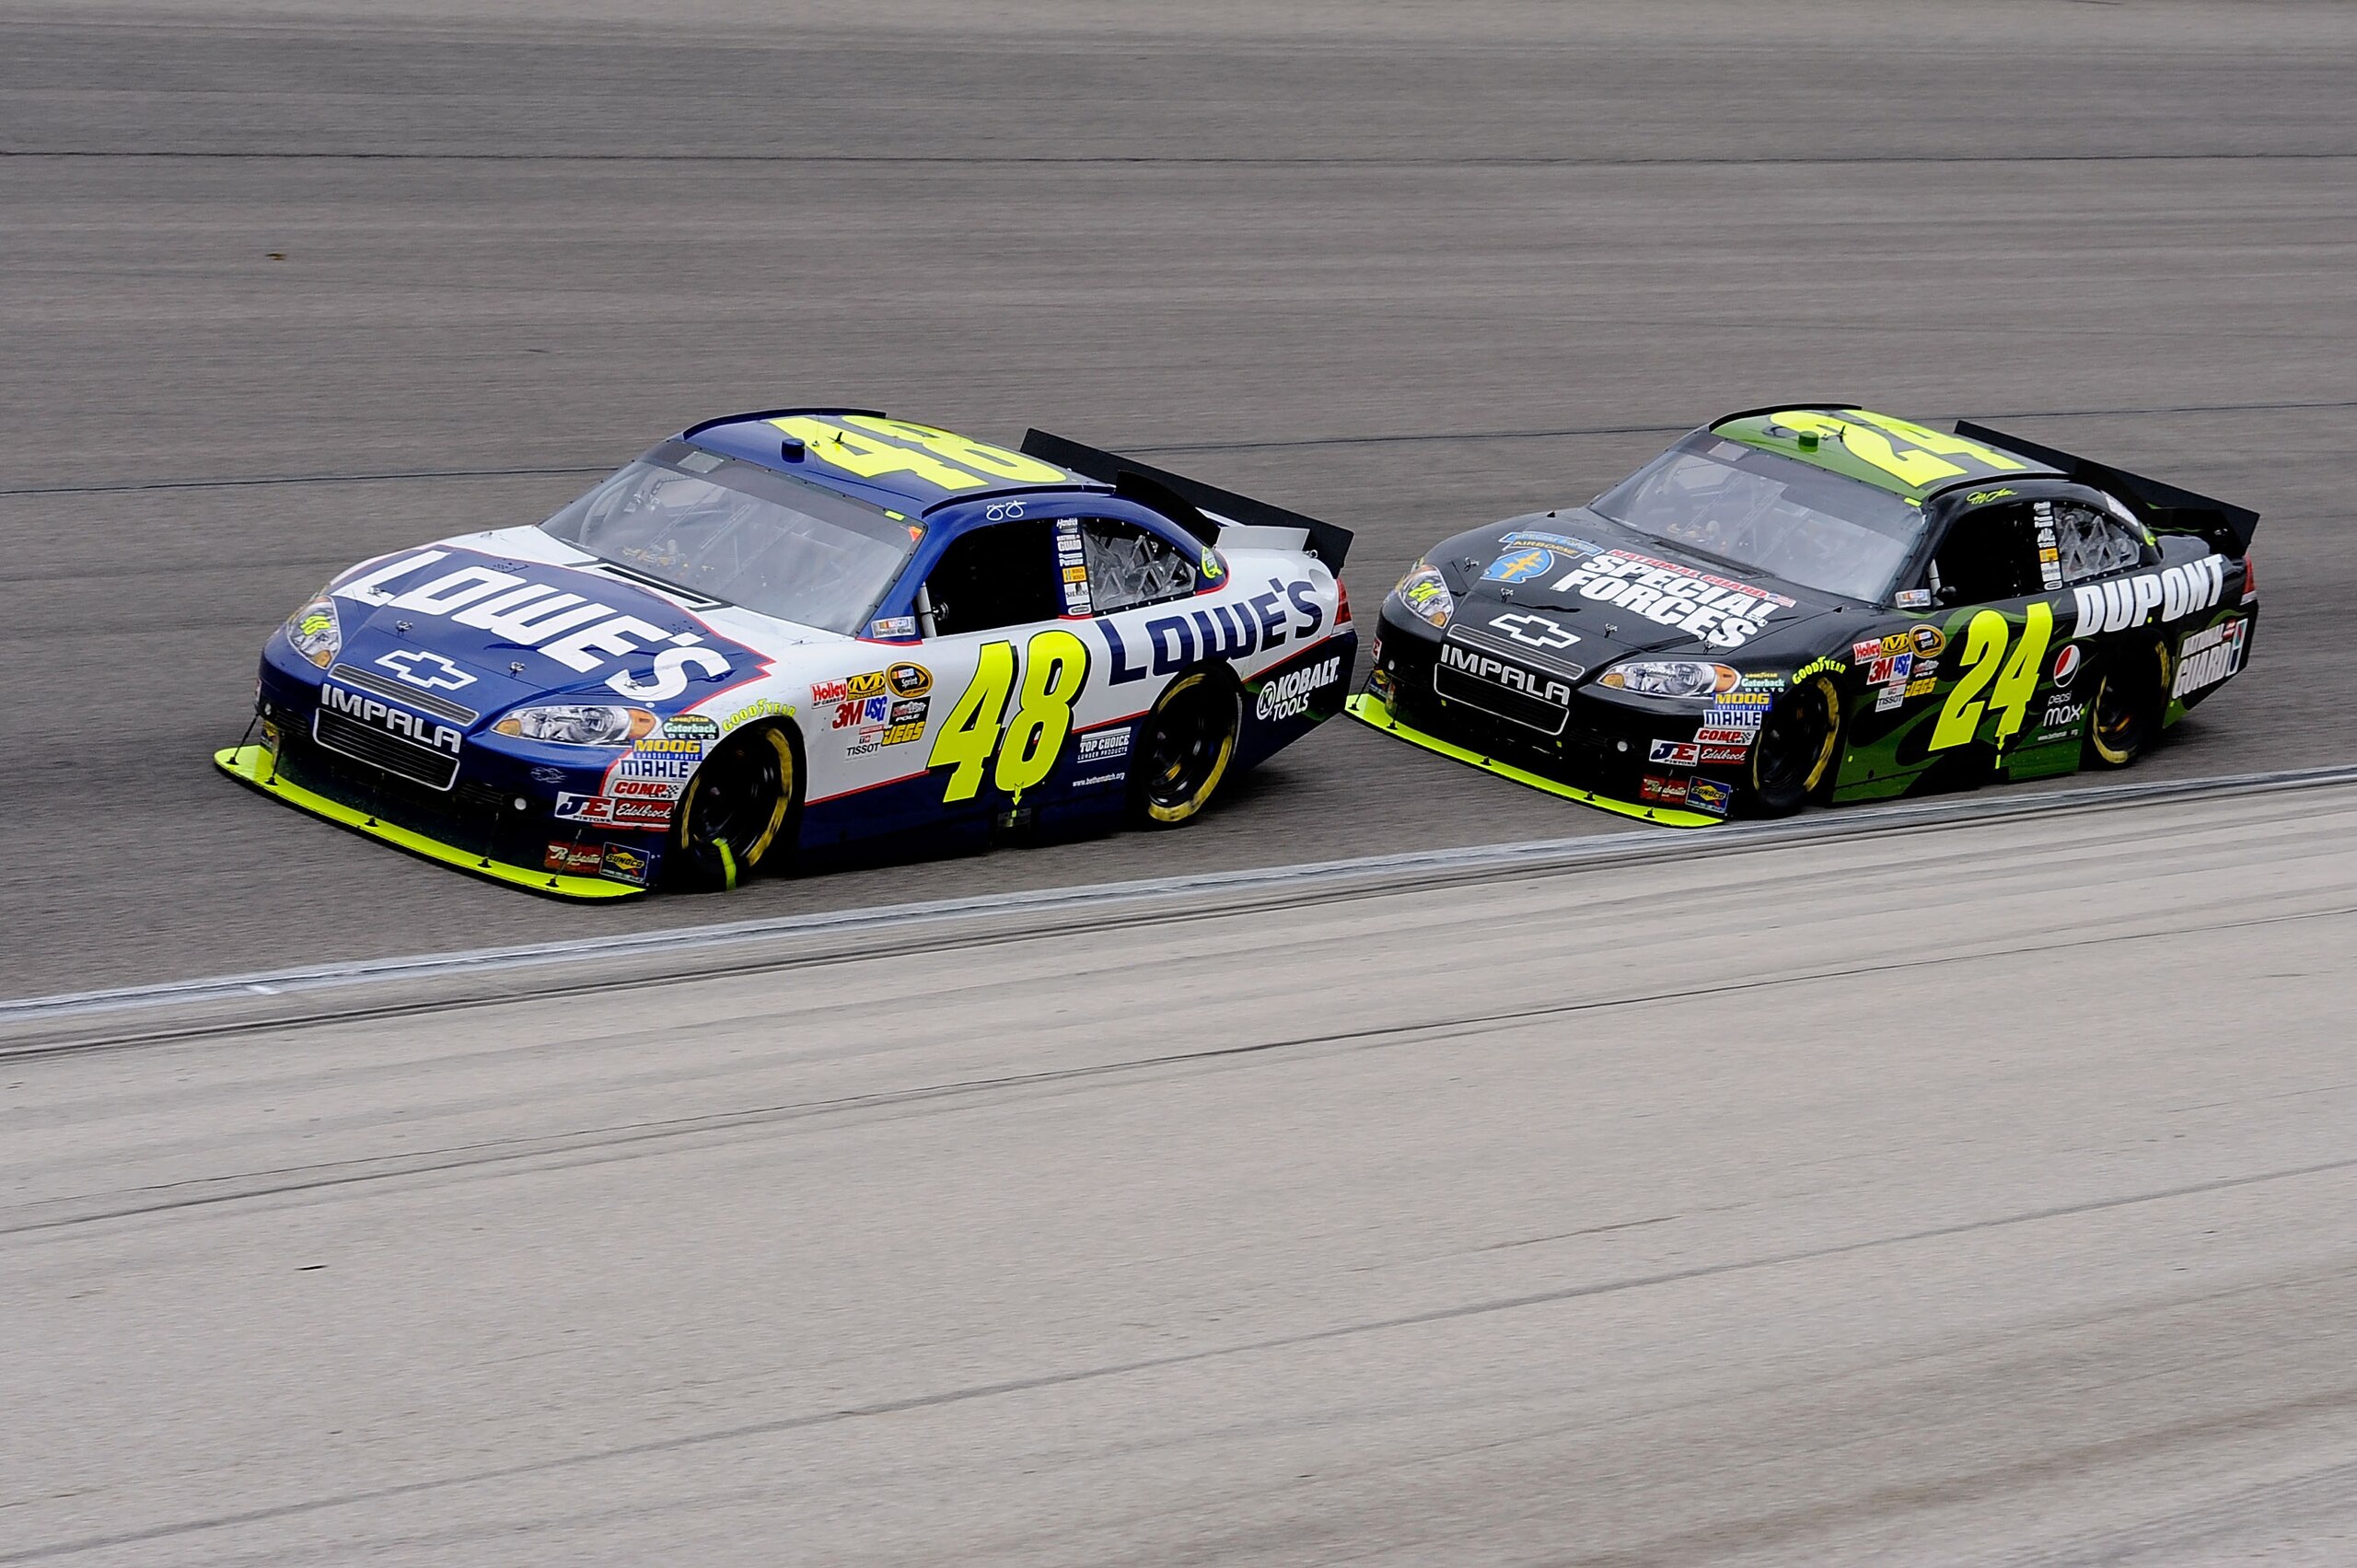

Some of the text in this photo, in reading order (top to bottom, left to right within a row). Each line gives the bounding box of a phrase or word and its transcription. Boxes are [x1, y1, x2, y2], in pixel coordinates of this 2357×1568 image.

[768, 414, 1067, 491] 48
[1770, 410, 2027, 488] 24
[1513, 540, 1579, 556] AIRBORNE
[1611, 550, 1767, 598] NATIONAL GUARD
[1408, 582, 1441, 603] 24
[1581, 554, 1781, 619] SPECIAL
[1549, 569, 1759, 647] FORCES
[300, 614, 331, 636] 48
[332, 550, 732, 702] LOWE'S
[1094, 576, 1324, 686] LOWE'S
[1854, 643, 1880, 658] Holley
[1440, 644, 1570, 705] IMPALA
[1792, 656, 1846, 685] GOODYEAR
[1869, 657, 1895, 683] 3M
[1928, 601, 2053, 751] 24
[2172, 641, 2232, 700] GUARD
[811, 681, 846, 702] Holley
[901, 677, 918, 689] Sprint
[1741, 678, 1785, 687] Gatorback
[1905, 677, 1937, 698] JEGS
[1273, 691, 1310, 721] TOOLS
[1714, 692, 1770, 704] MOOG
[1878, 695, 1903, 707] TISSOT
[2048, 691, 2073, 706] pepsi
[321, 683, 461, 753] IMPALA
[723, 698, 796, 732] GOODYEAR
[832, 701, 865, 729] 3M
[865, 696, 888, 723] USG
[895, 714, 920, 722] POLE
[927, 631, 1089, 803] 48
[1705, 711, 1760, 726] MAHLE
[2043, 703, 2083, 726] max
[663, 722, 717, 734] Gatorback
[881, 721, 926, 747] JEGS
[1698, 730, 1742, 741] COMP
[634, 738, 701, 753] MOOG
[846, 742, 880, 757] TISSOT
[1080, 735, 1130, 753] TOP CHOICE
[1651, 743, 1698, 761] JE
[1701, 747, 1746, 761] Edelbrock
[621, 760, 689, 778] MAHLE
[614, 782, 668, 796] COMP
[1692, 785, 1726, 800] SUNOCO
[556, 796, 612, 818] JE
[615, 803, 671, 819] Edelbrock
[573, 815, 611, 823] PISTONS
[607, 854, 644, 868] SUNOCO
